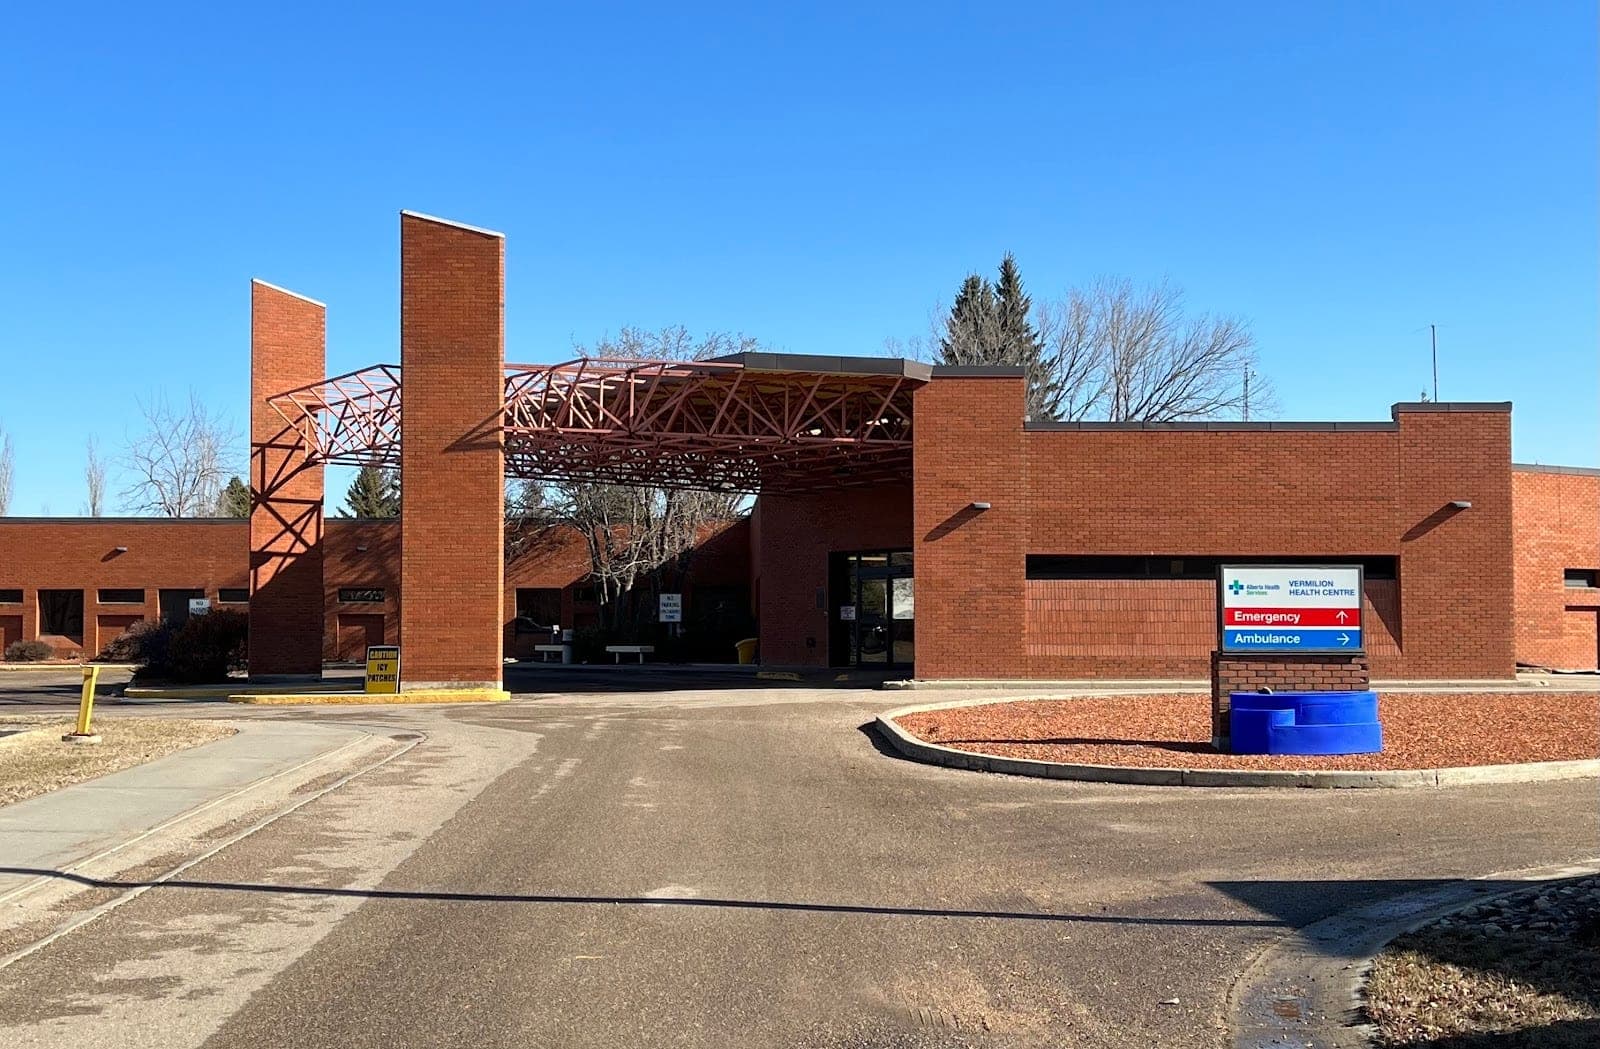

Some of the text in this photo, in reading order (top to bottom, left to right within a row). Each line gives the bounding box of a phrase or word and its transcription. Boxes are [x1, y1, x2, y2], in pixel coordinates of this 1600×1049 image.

[1288, 580, 1334, 588] VERMILION
[1289, 589, 1356, 597] HEALTH CENTRE
[1234, 611, 1301, 624] Emergency
[1234, 633, 1301, 644] Ambulance
[369, 650, 398, 659] CAUTION
[377, 663, 388, 671] ICY
[367, 674, 396, 682] PATCHES
